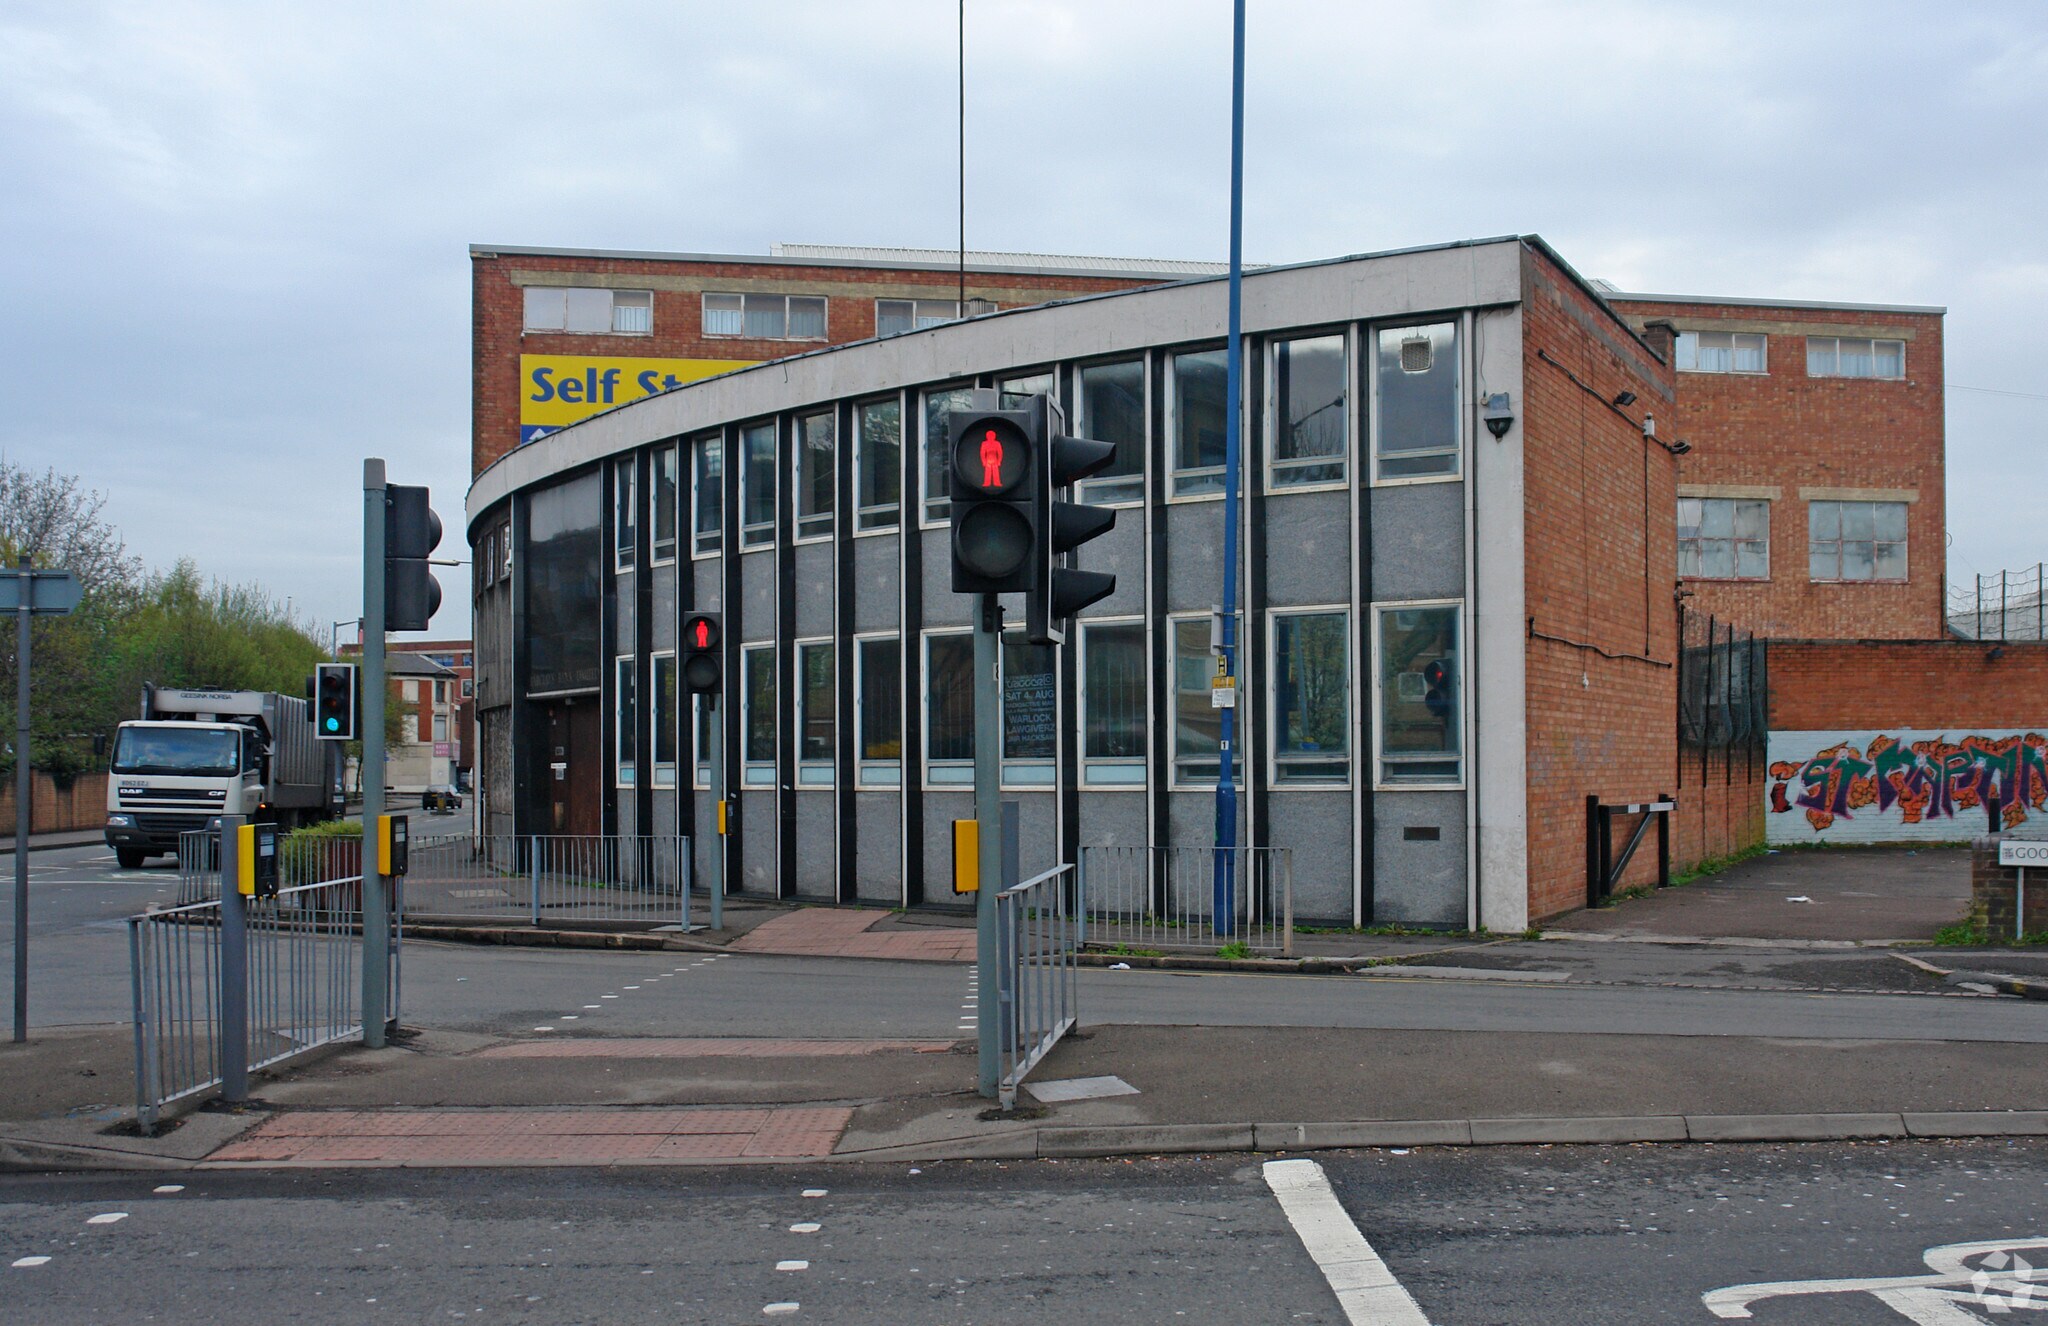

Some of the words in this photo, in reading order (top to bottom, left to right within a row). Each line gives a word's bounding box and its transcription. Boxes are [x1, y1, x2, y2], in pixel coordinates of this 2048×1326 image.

[530, 367, 621, 404] Self
[1006, 692, 1022, 702] SAT
[1035, 690, 1054, 699] AUG
[1009, 714, 1052, 723] WARLOCK
[2015, 847, 2048, 859] GOO
